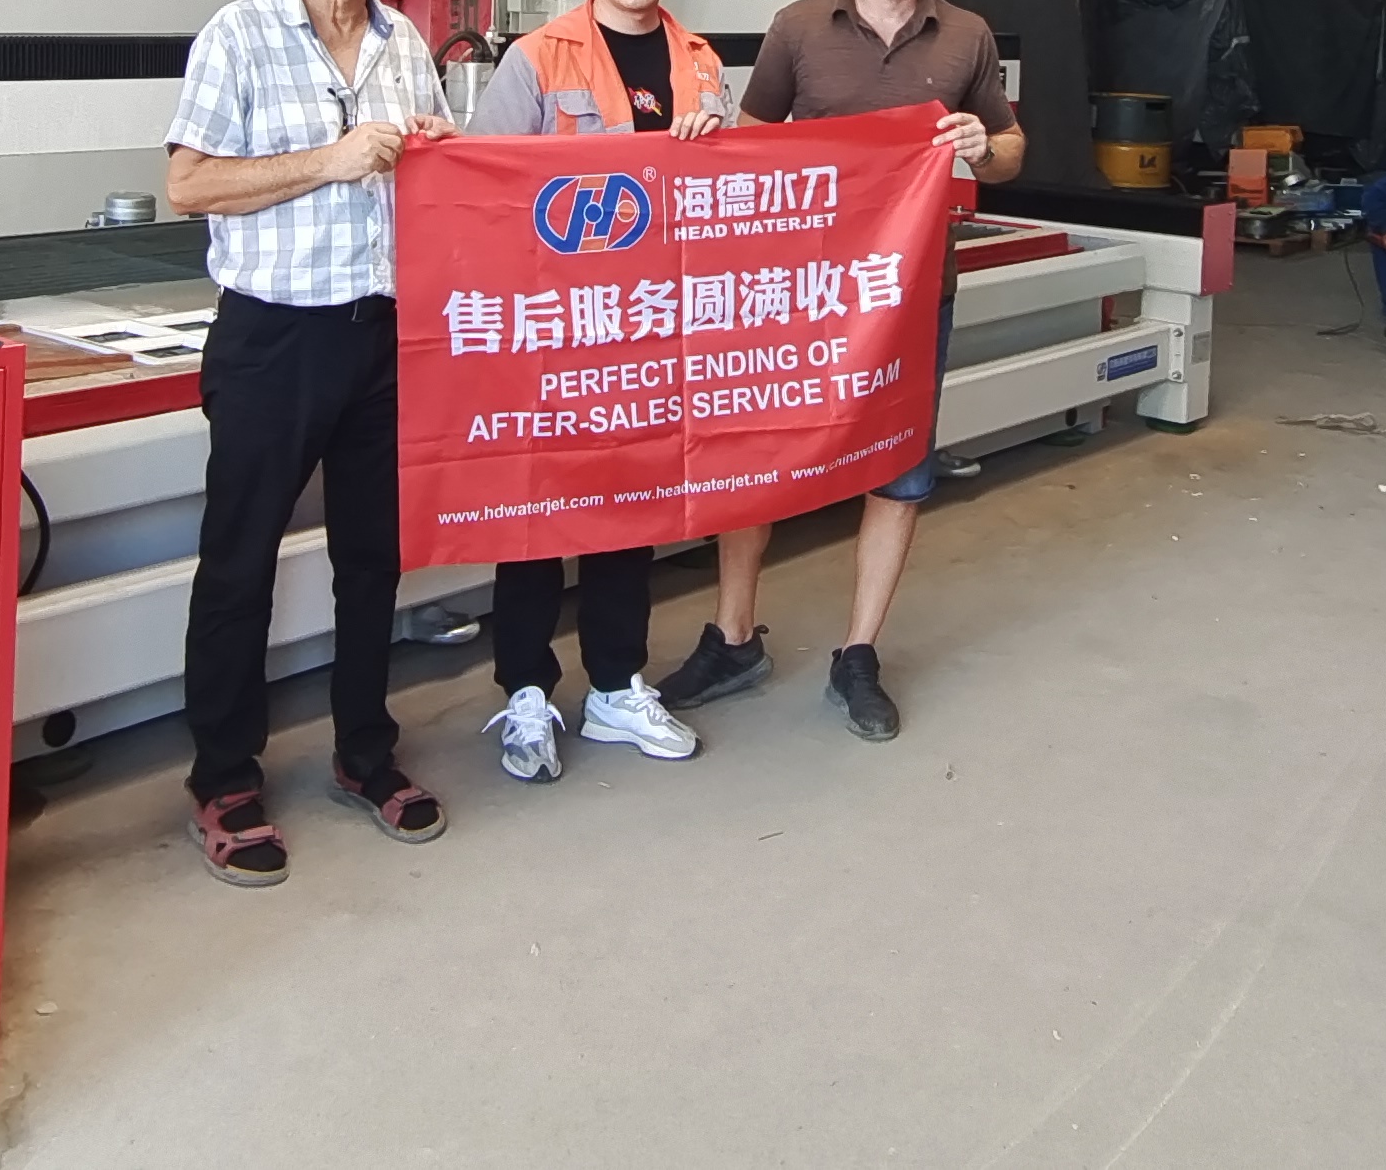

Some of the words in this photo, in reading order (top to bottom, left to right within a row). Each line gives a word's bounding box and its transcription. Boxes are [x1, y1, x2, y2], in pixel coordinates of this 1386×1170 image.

[673, 165, 838, 222] 海德水刀
[674, 224, 728, 241] HEAD
[732, 212, 837, 237] WATERJET
[441, 252, 904, 356] 售后服务圆满收官
[540, 358, 678, 401] PERFECT
[685, 348, 799, 380] ENDING
[807, 337, 848, 366] OF
[466, 396, 684, 443] AFTER-SALES
[692, 379, 824, 419] SERVICE
[831, 357, 901, 401] TEAM
[438, 492, 604, 526] www.hdwaterjet.com
[613, 469, 779, 505] www.headwaterjet.net
